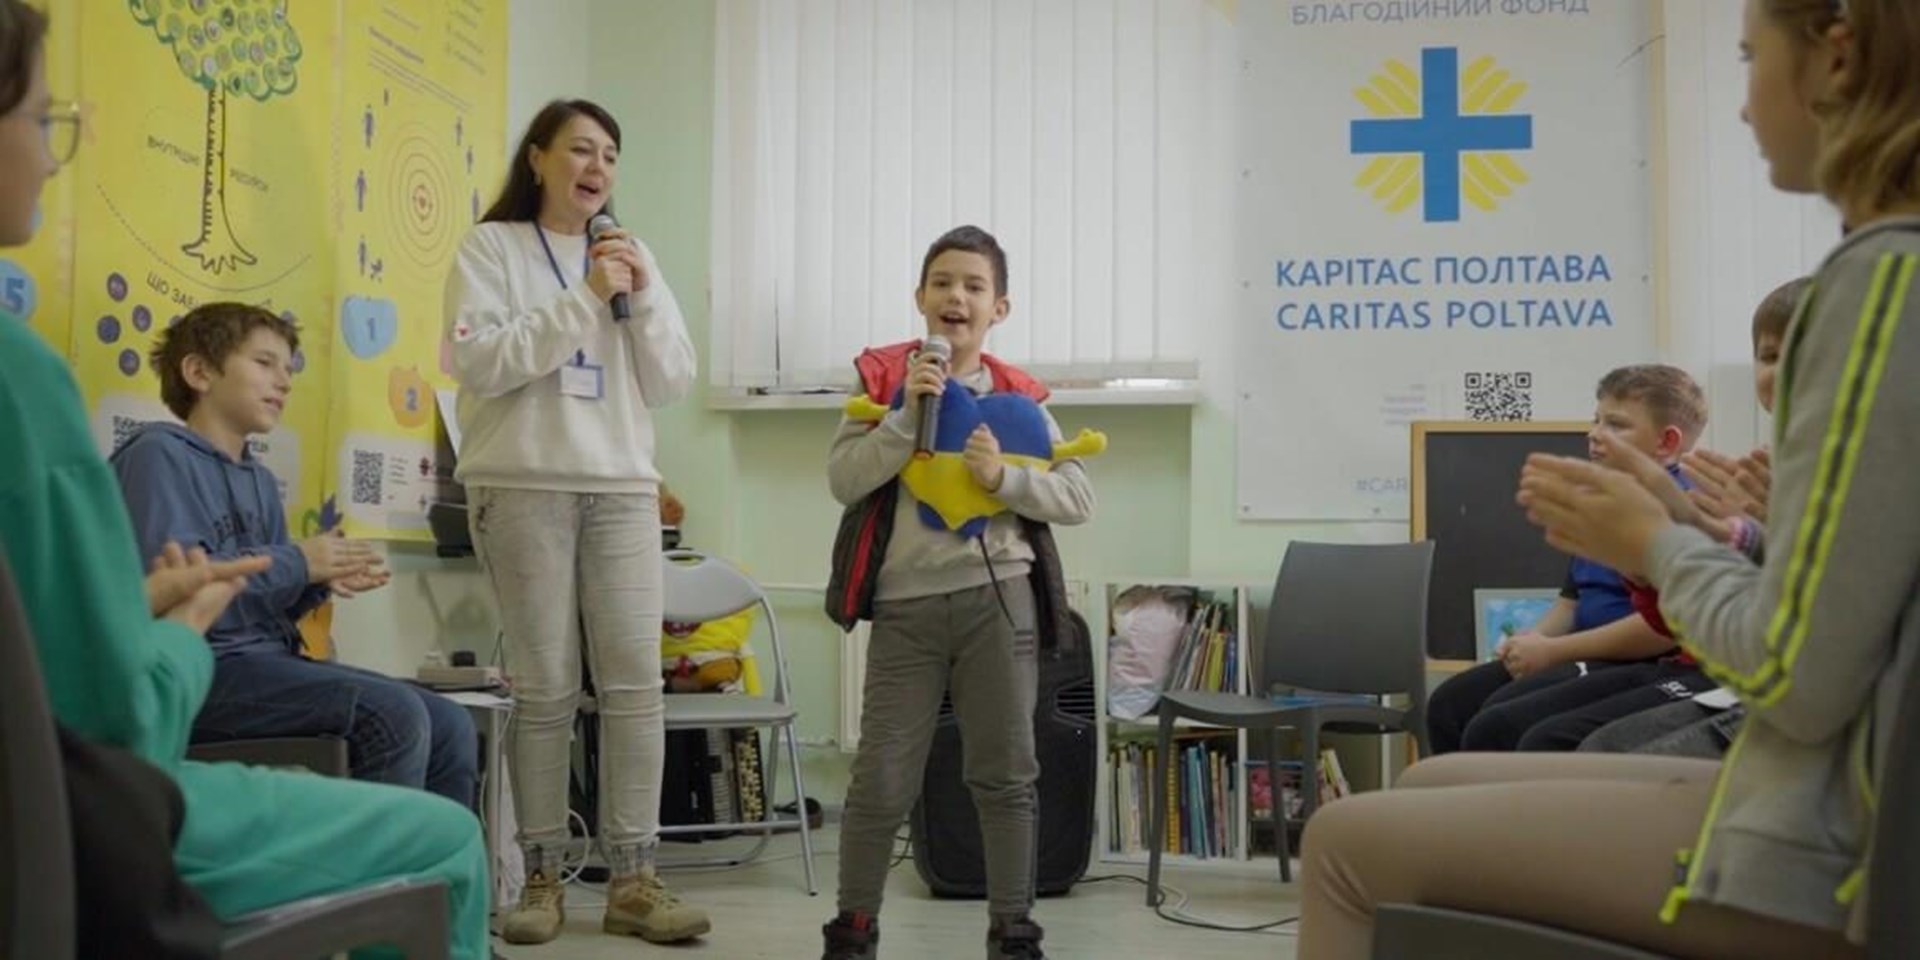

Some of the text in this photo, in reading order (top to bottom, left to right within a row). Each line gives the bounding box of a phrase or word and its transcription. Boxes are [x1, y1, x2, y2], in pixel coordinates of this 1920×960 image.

[1292, 0, 1590, 26] БЛАГОДІЙНИЙ ФОНД
[146, 270, 170, 295] ЩО
[1276, 254, 1612, 287] КАРІТАС ПОЛТАВА
[6, 277, 25, 314] 5
[1277, 299, 1613, 330] CARITAS POLTAVA
[367, 316, 377, 341] 1
[405, 387, 418, 411] 2
[1356, 476, 1409, 492] #CAR
